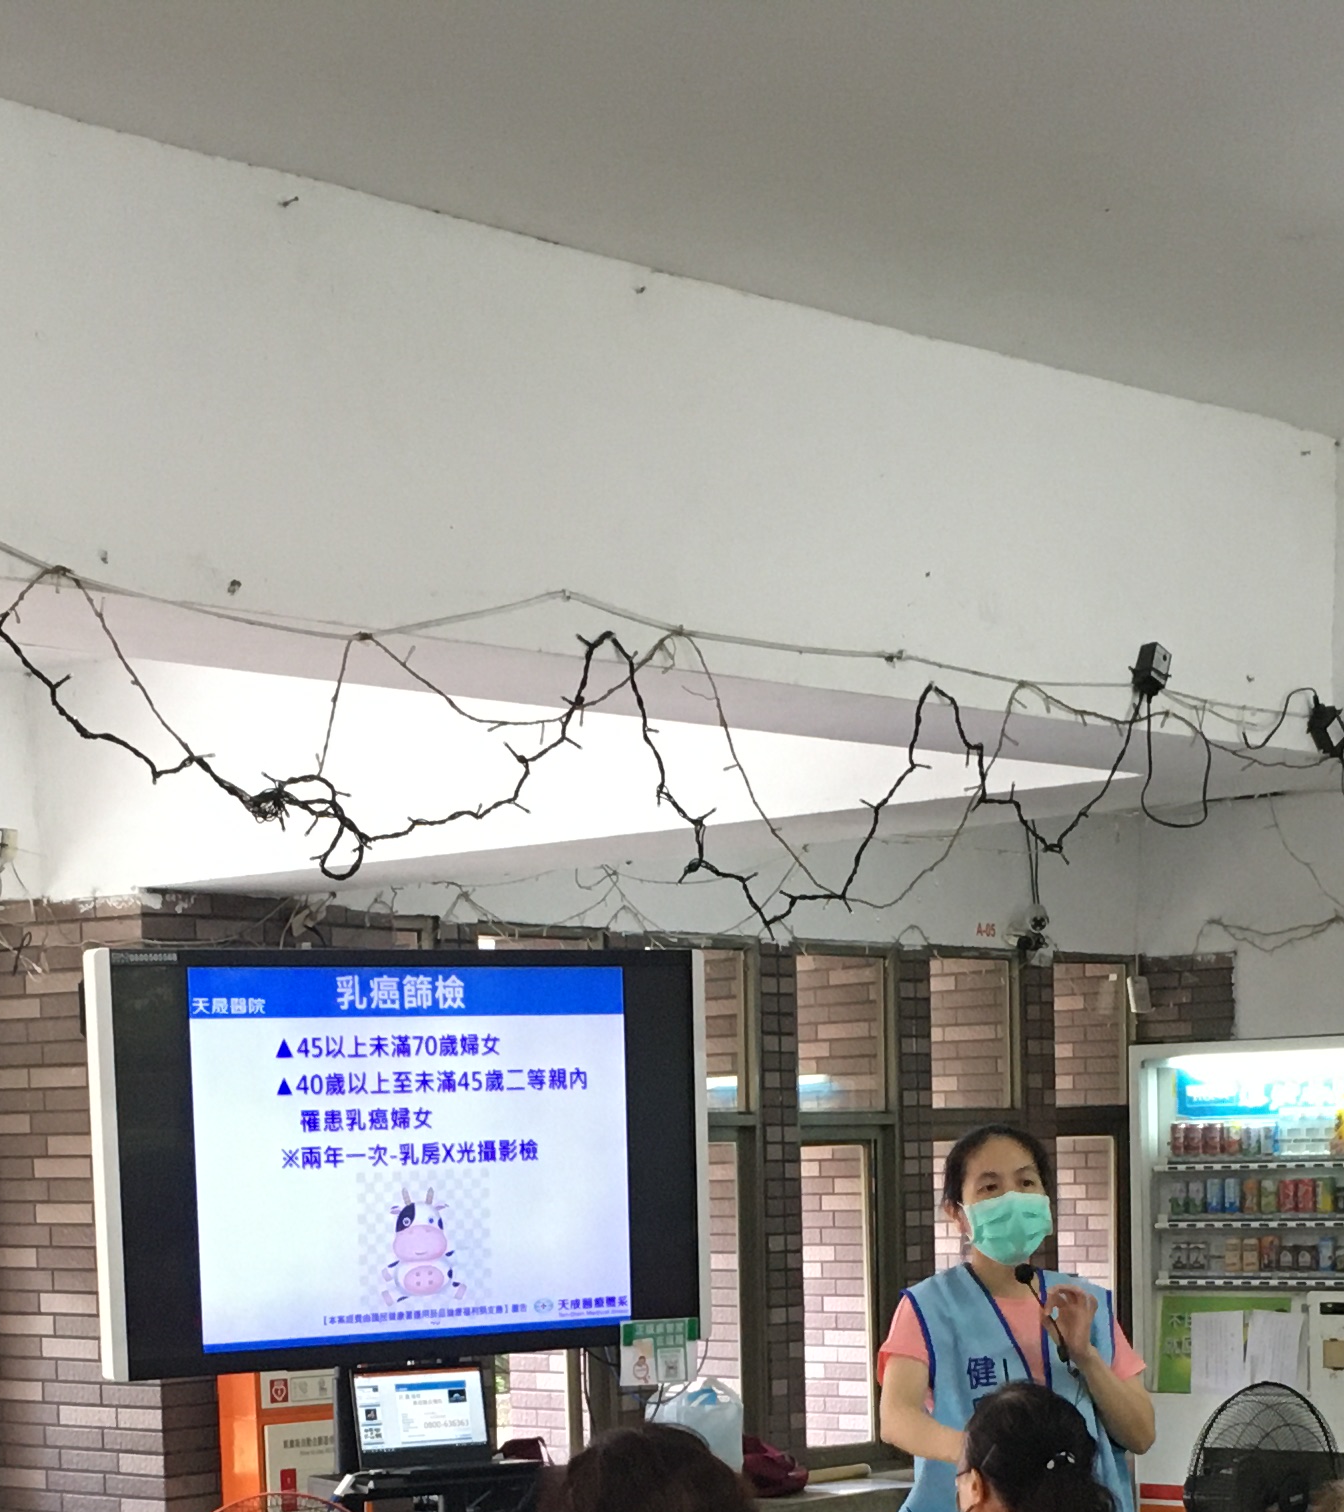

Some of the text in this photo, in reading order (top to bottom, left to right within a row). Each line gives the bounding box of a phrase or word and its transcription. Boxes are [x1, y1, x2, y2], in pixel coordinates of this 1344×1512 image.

[192, 996, 266, 1015] 天晟醫院
[335, 974, 466, 1011] 乳癌篩檢
[296, 1033, 501, 1059] 45以上未滿70歲婦女
[295, 1066, 589, 1096] 40歲以上至未滿45歲二等親內
[299, 1106, 433, 1133] 罹患乳癌婦女
[966, 1355, 1009, 1390] 健
